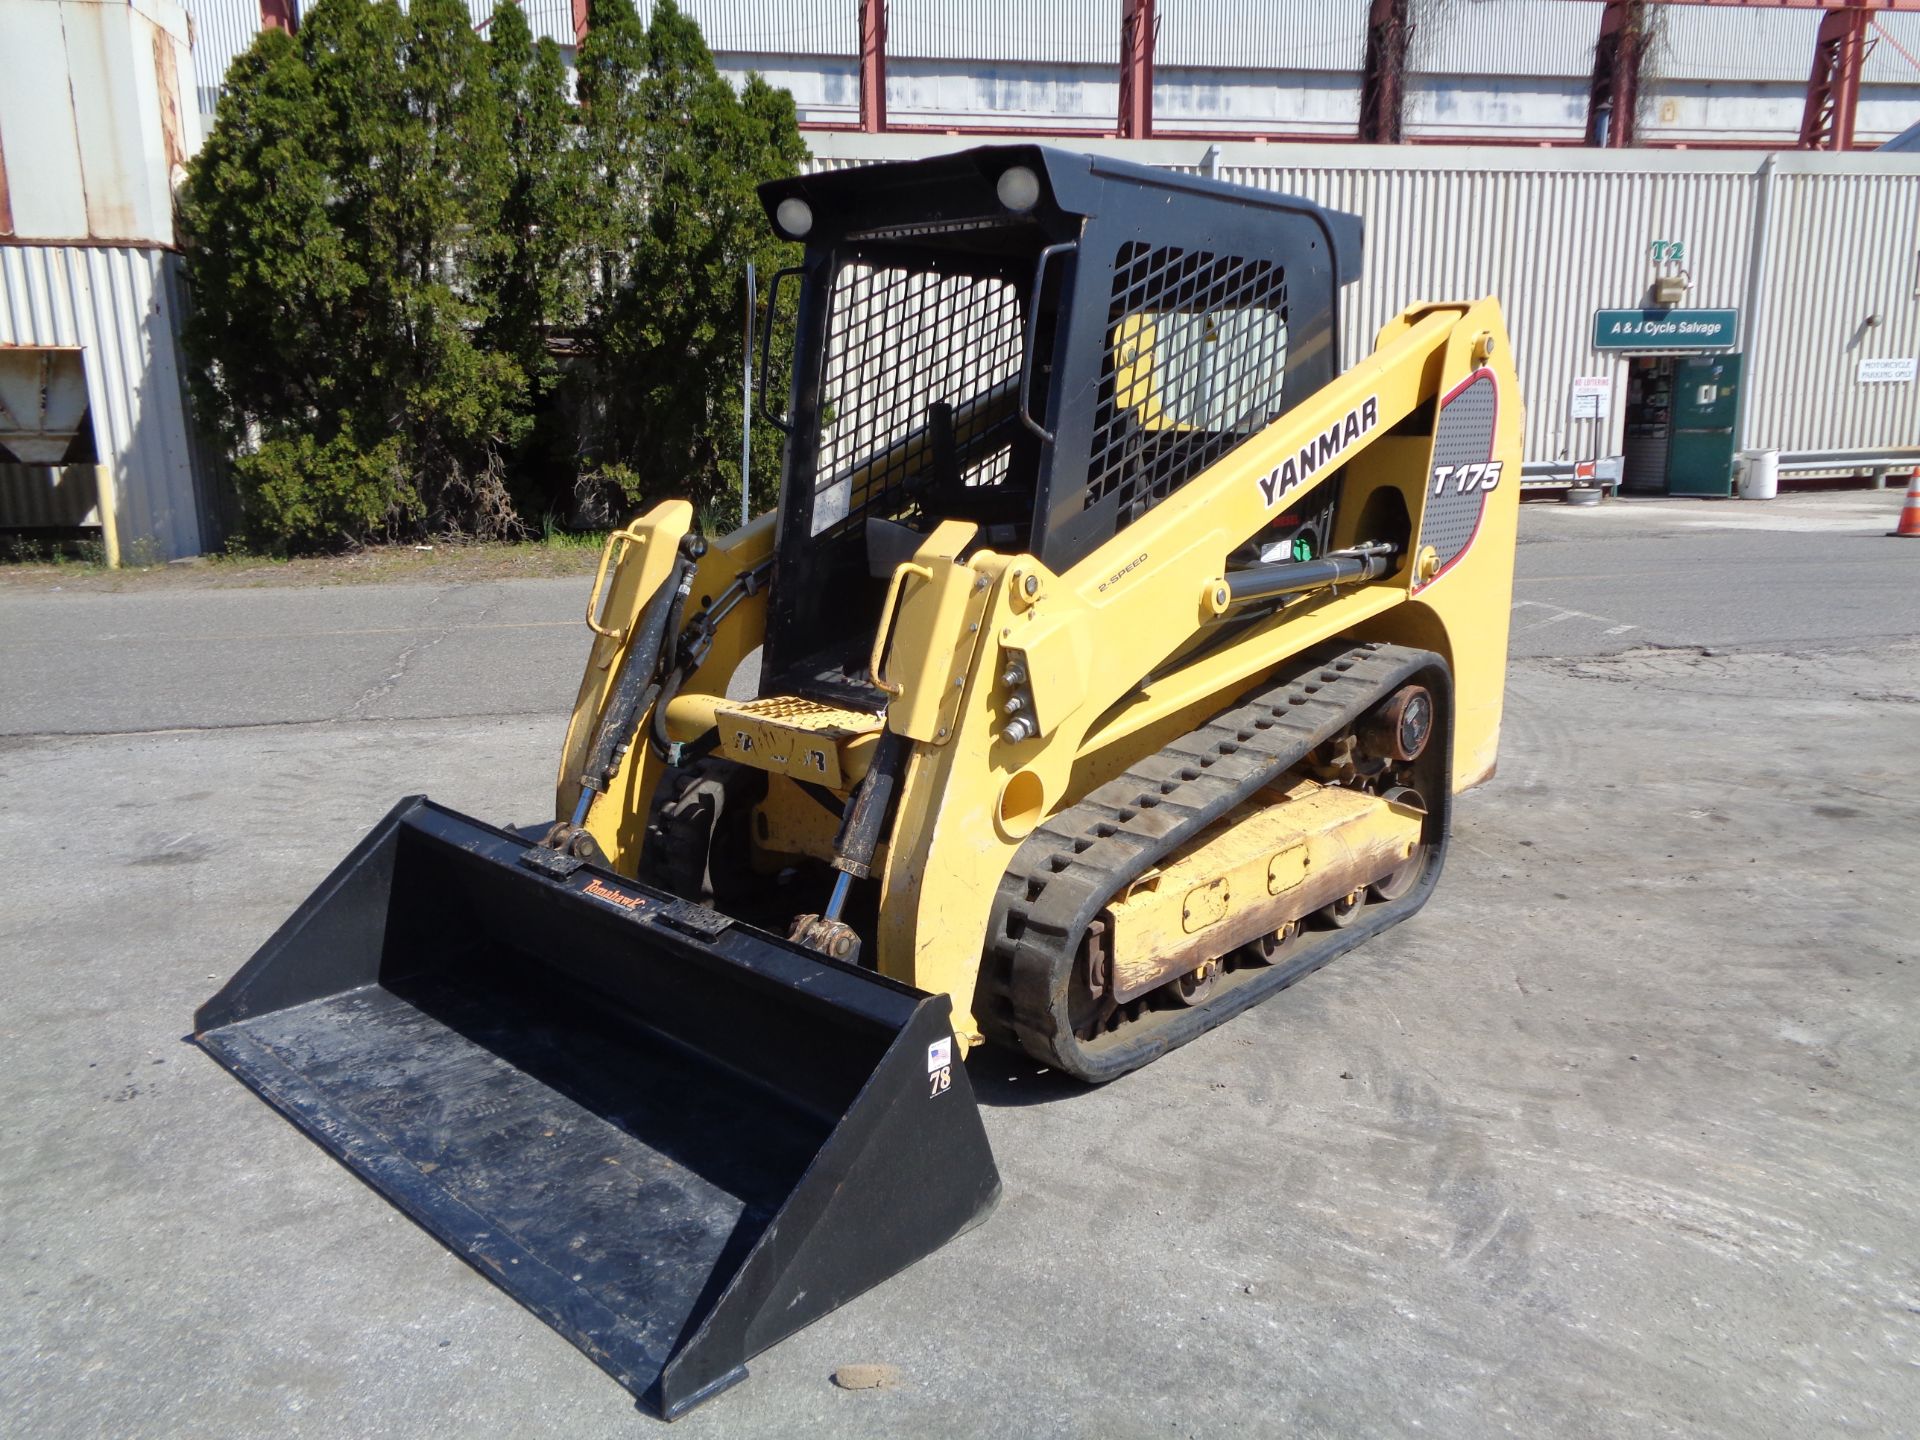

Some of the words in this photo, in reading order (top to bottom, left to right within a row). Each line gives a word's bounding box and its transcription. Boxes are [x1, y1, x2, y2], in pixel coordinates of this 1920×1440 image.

[1652, 240, 1684, 260] T2
[1611, 322, 1621, 334] A
[1622, 322, 1632, 334] &
[1634, 322, 1643, 334] J
[1644, 322, 1676, 336] Cycle
[1678, 321, 1721, 336] Salvage
[1259, 395, 1377, 507] YANMAR
[1098, 553, 1148, 593] 2-SPEED
[582, 879, 646, 909] Tomahawk
[929, 1066, 951, 1095] 78
